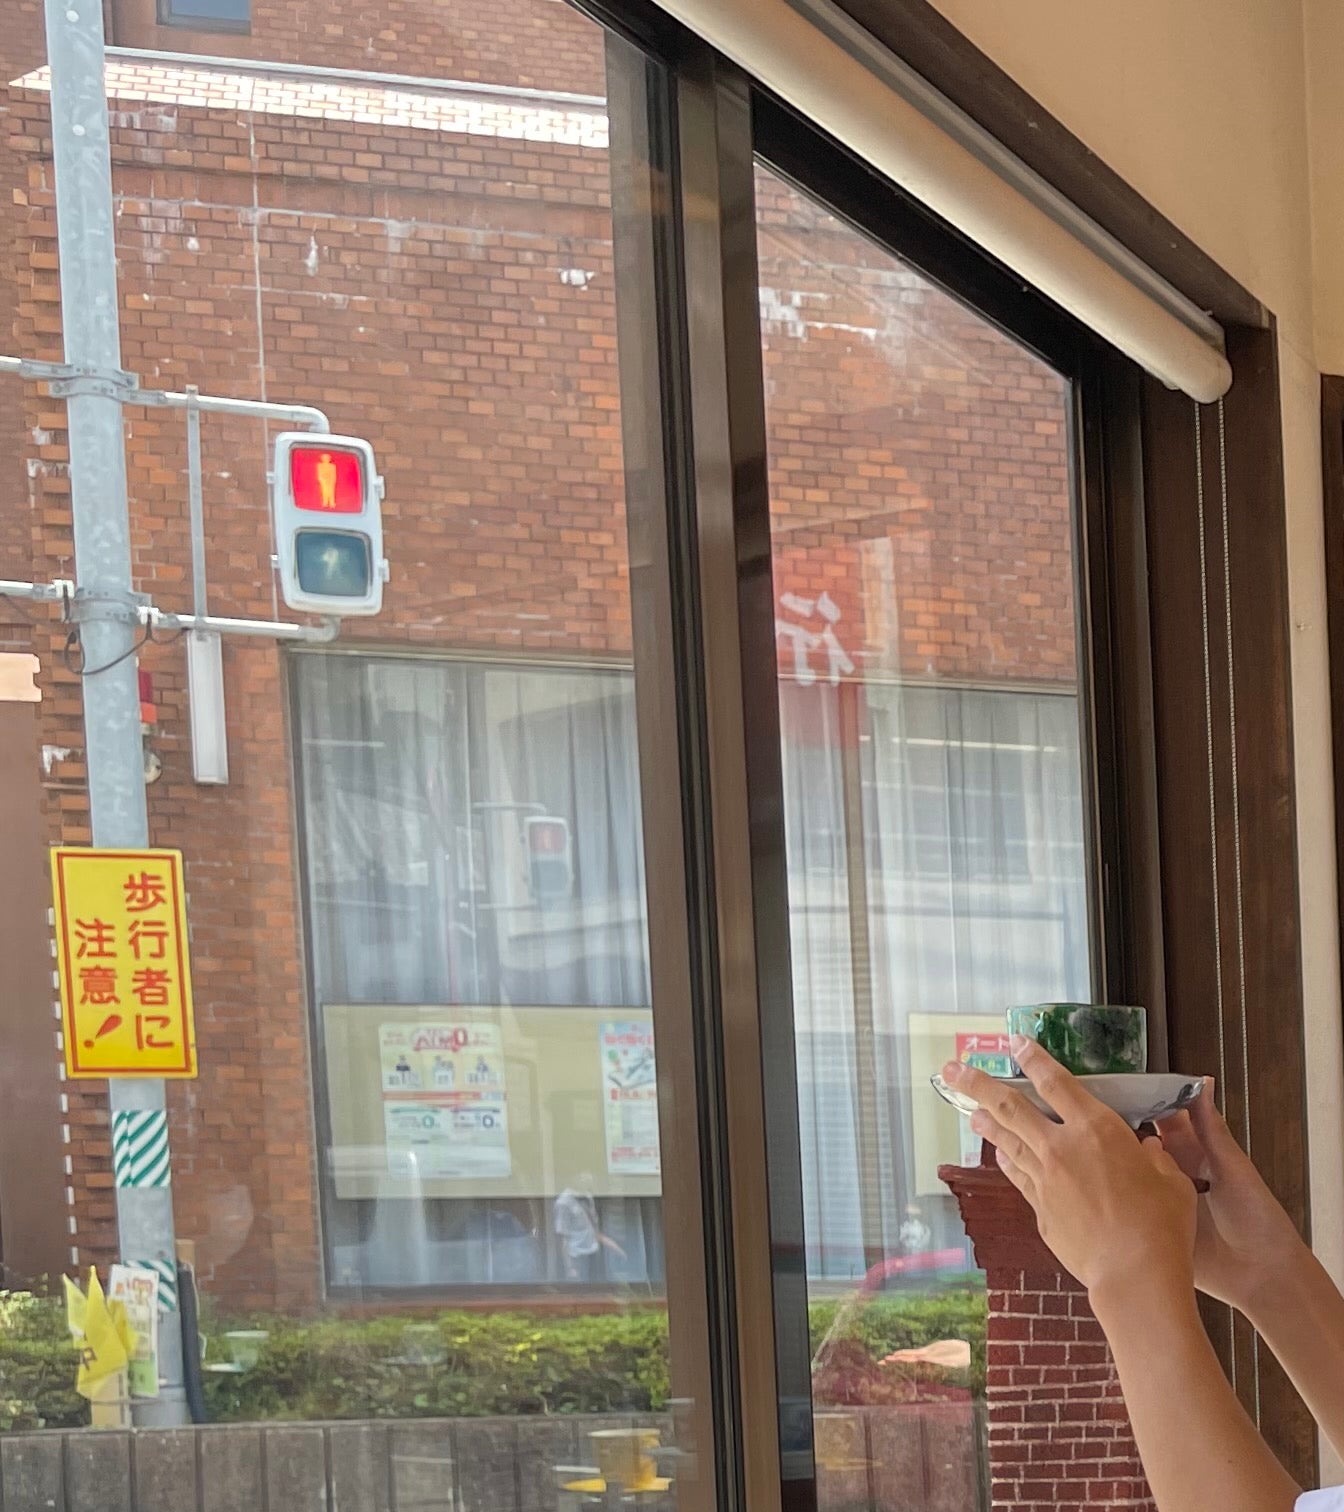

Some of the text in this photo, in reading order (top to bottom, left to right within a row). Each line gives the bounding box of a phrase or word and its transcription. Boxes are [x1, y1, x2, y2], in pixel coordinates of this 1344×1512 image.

[74, 918, 122, 1049] 注意！
[123, 871, 174, 1051] 歩行者に
